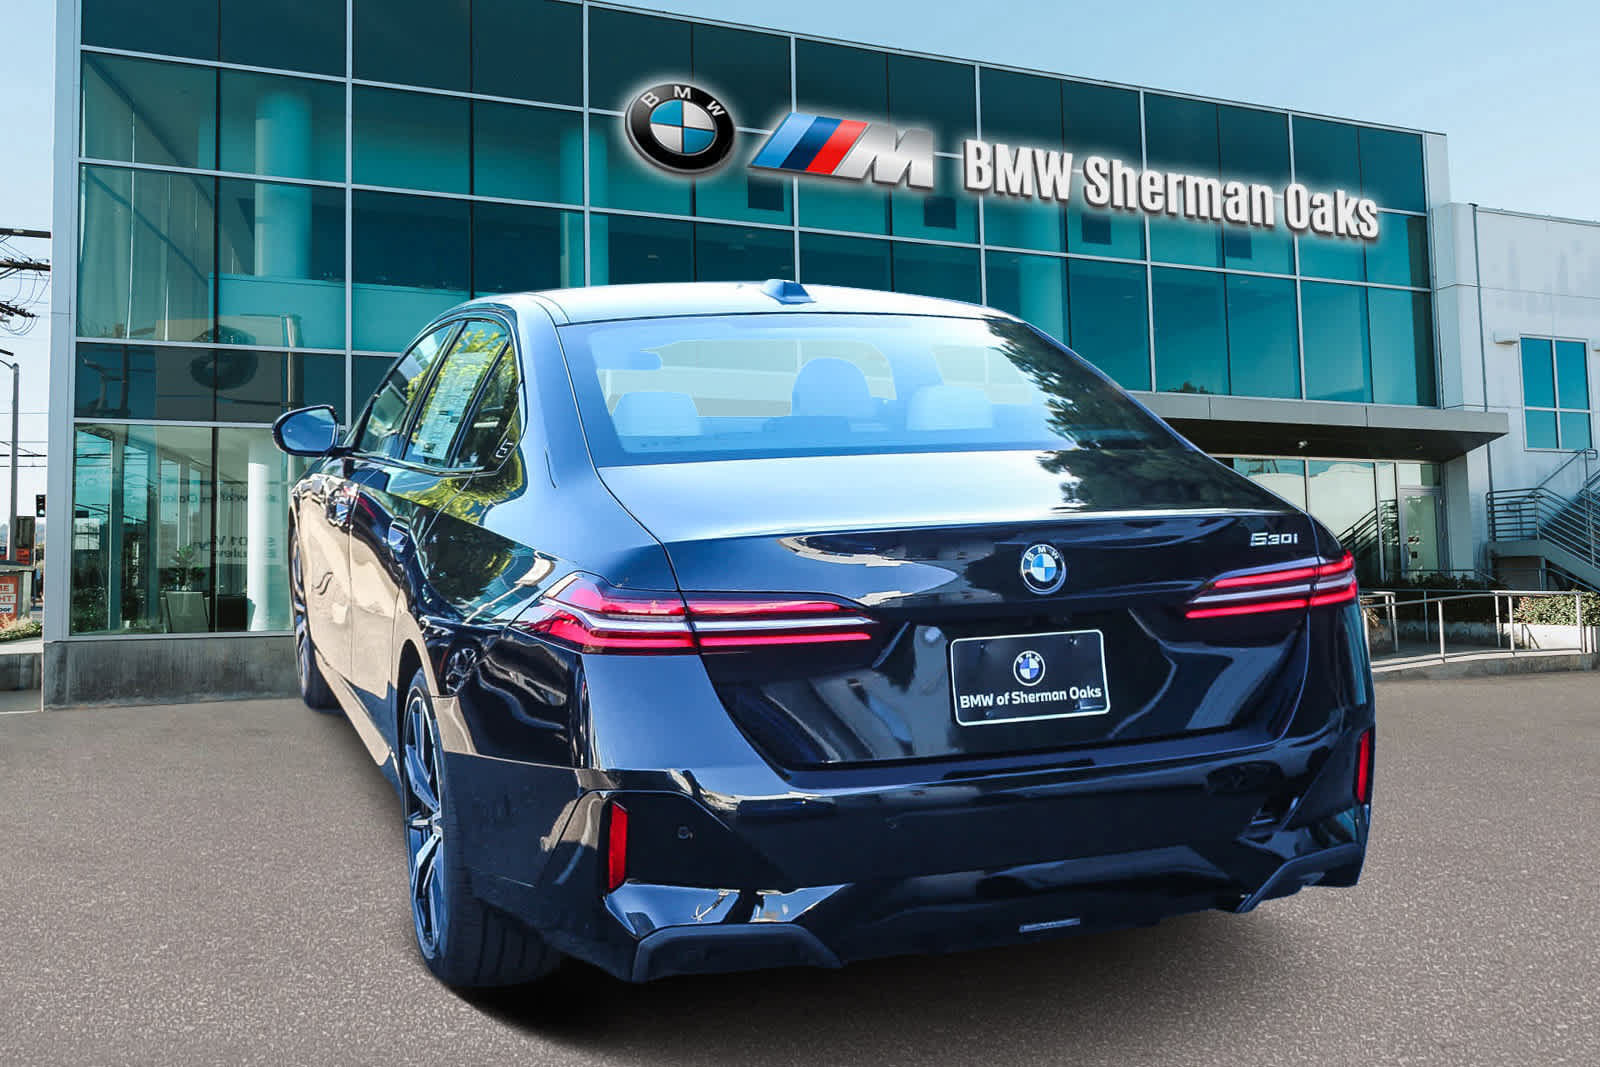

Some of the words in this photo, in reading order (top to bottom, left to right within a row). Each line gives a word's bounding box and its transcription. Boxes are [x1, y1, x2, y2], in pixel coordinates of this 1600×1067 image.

[640, 84, 726, 118] BMW
[963, 137, 1073, 201] BMW
[1082, 154, 1275, 228] Sherman
[1283, 182, 1379, 240] Oaks
[1250, 532, 1299, 547] 530i
[1024, 545, 1060, 561] BMW
[959, 693, 994, 709] BMW
[996, 692, 1010, 706] of
[1011, 689, 1067, 705] Sherman
[1069, 684, 1102, 700] Oaks
